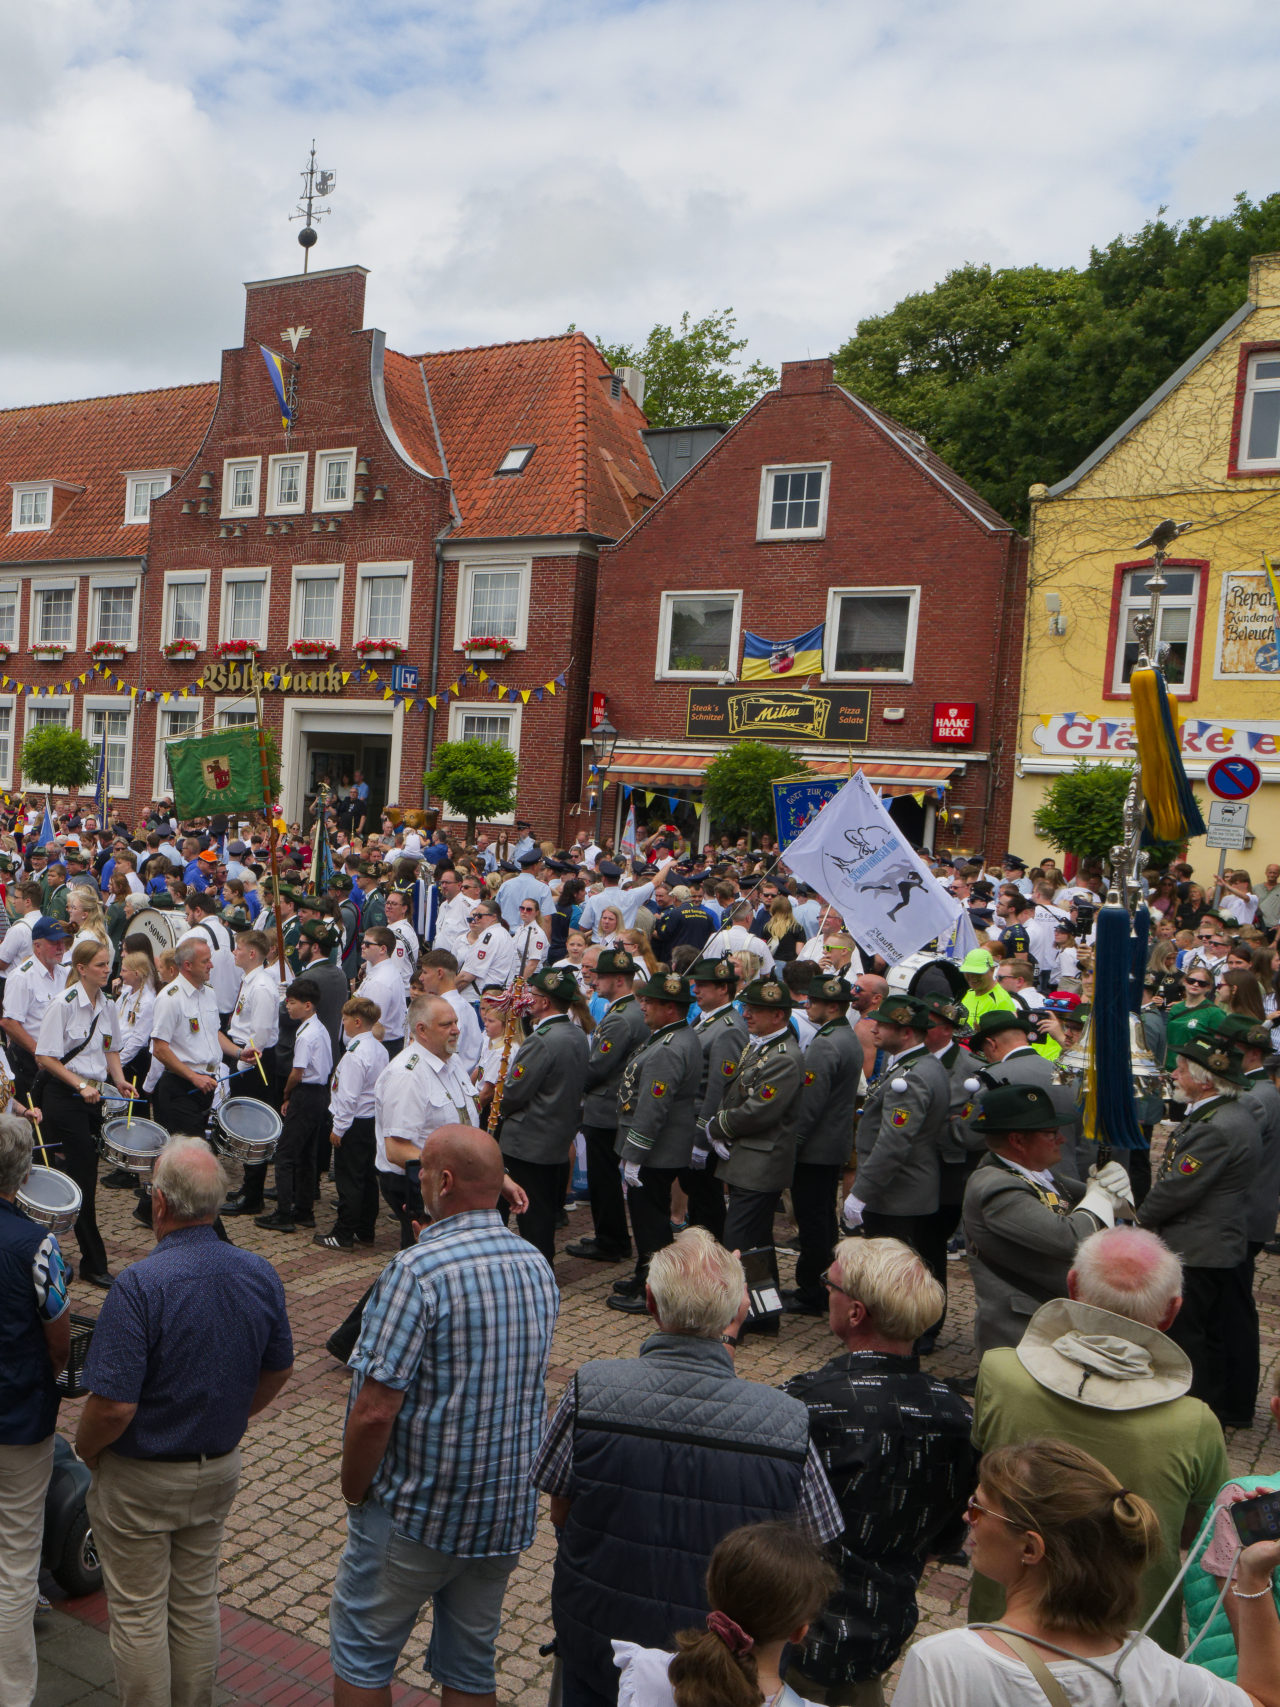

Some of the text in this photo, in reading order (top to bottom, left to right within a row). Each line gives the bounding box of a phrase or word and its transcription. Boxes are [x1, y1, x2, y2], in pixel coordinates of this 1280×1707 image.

[754, 706, 800, 722] Milieu
[839, 706, 861, 715] Pizza
[691, 712, 724, 721] Schnitzel
[838, 715, 864, 724] Salate
[935, 718, 970, 728] HAAKE
[938, 727, 965, 737] BECK
[1056, 721, 1235, 753] Gläke
[806, 788, 822, 796] ZUR
[149, 923, 167, 948] SONOR
[876, 930, 904, 960] Lauftreff
